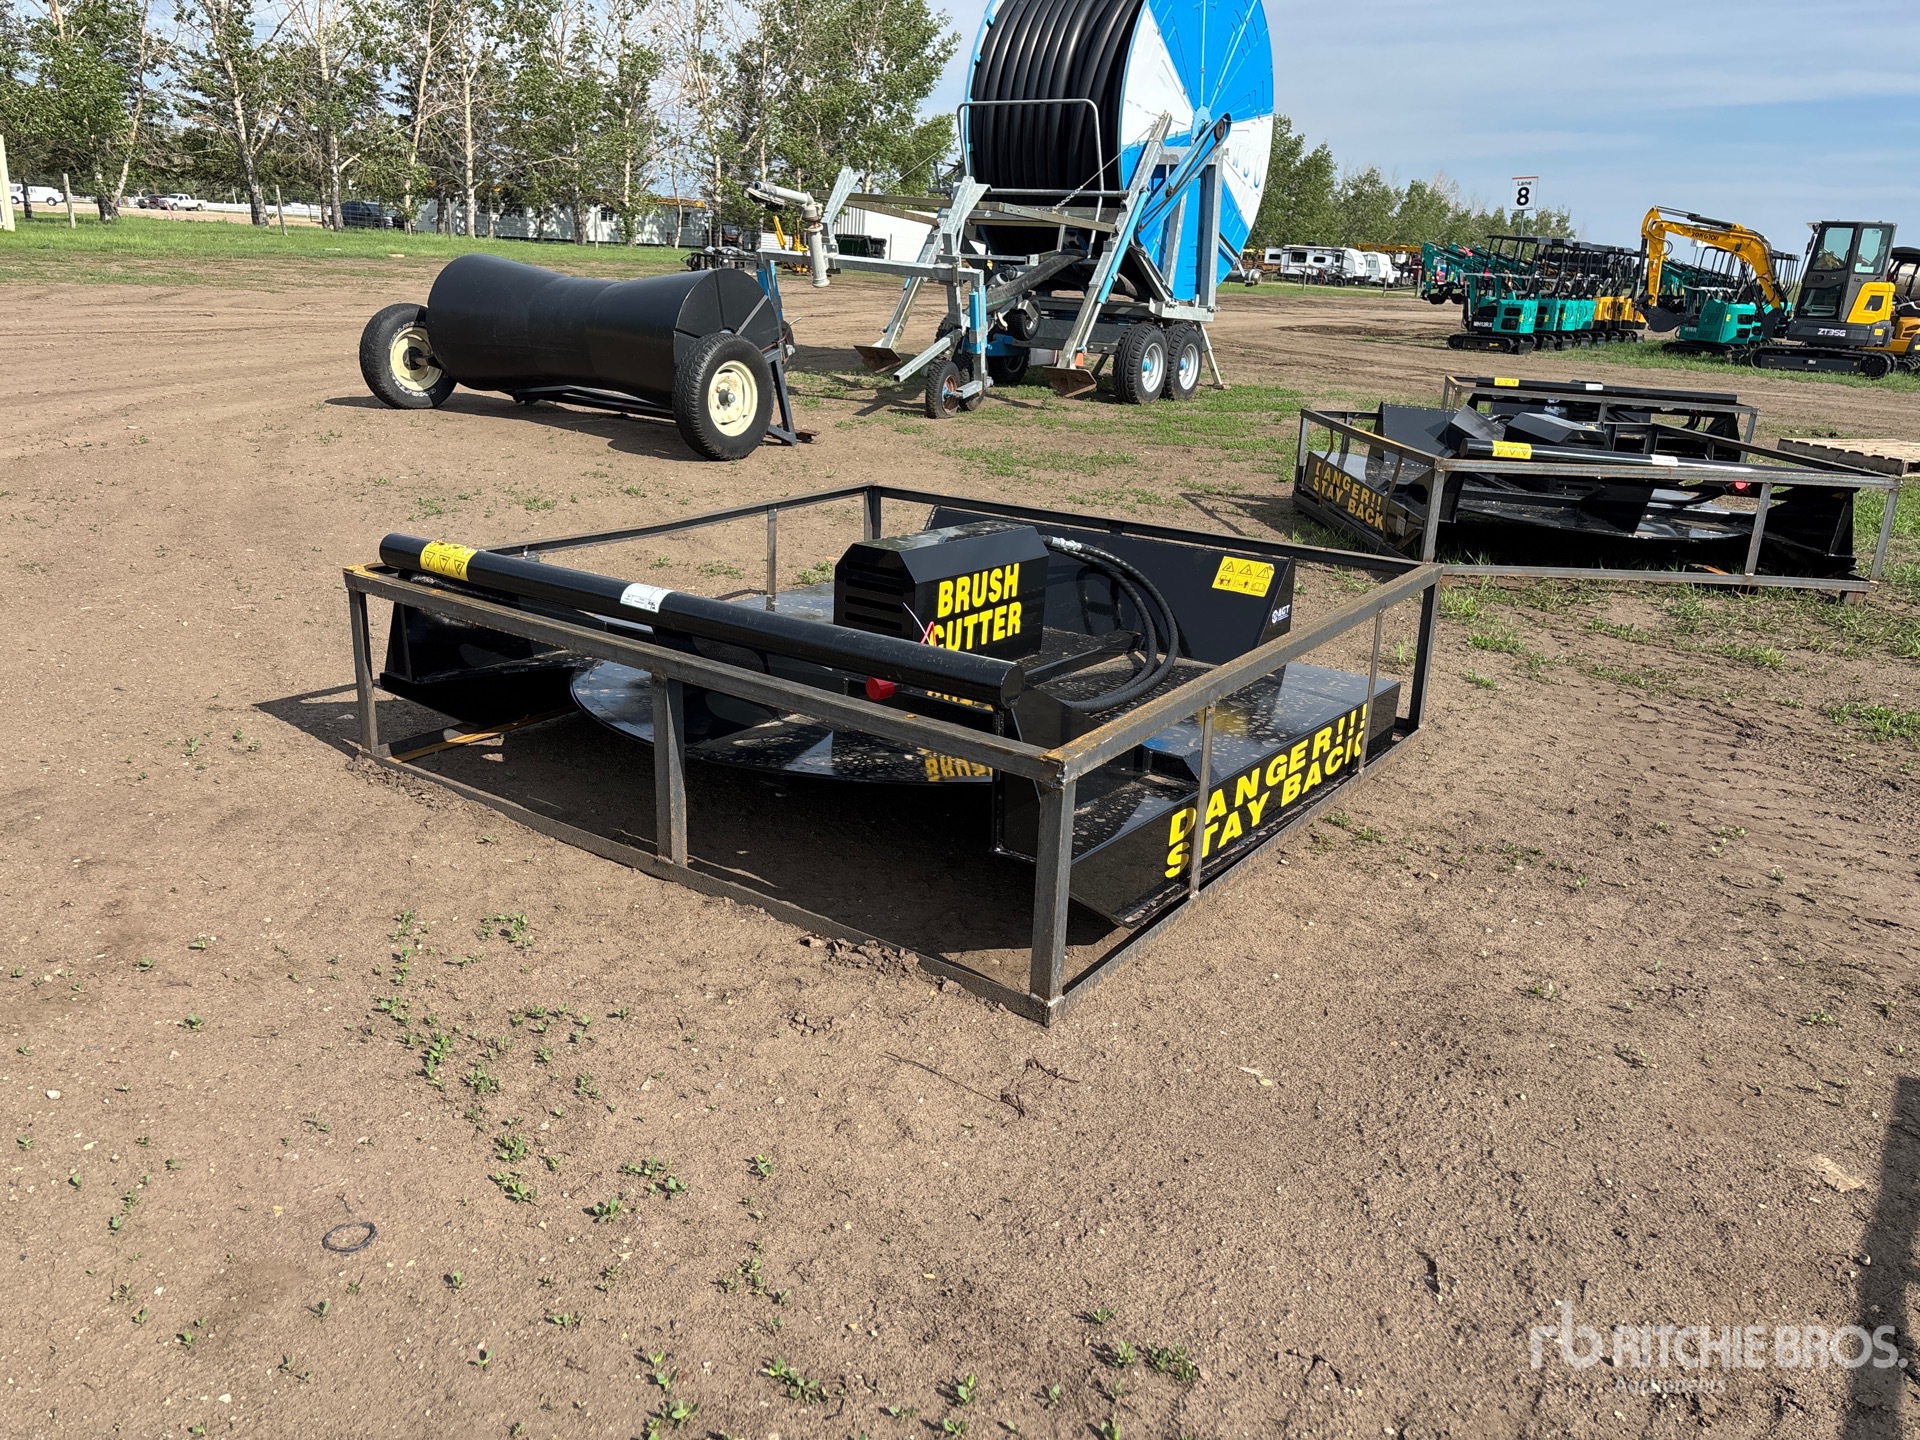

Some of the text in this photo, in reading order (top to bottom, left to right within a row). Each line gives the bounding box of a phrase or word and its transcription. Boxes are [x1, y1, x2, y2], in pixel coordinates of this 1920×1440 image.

[1516, 187, 1530, 206] 8
[1313, 477, 1384, 532] STAY BACK
[937, 562, 1020, 619] BRUSH
[929, 601, 1022, 652] CUTTER
[1165, 731, 1365, 878] STAY BACK
